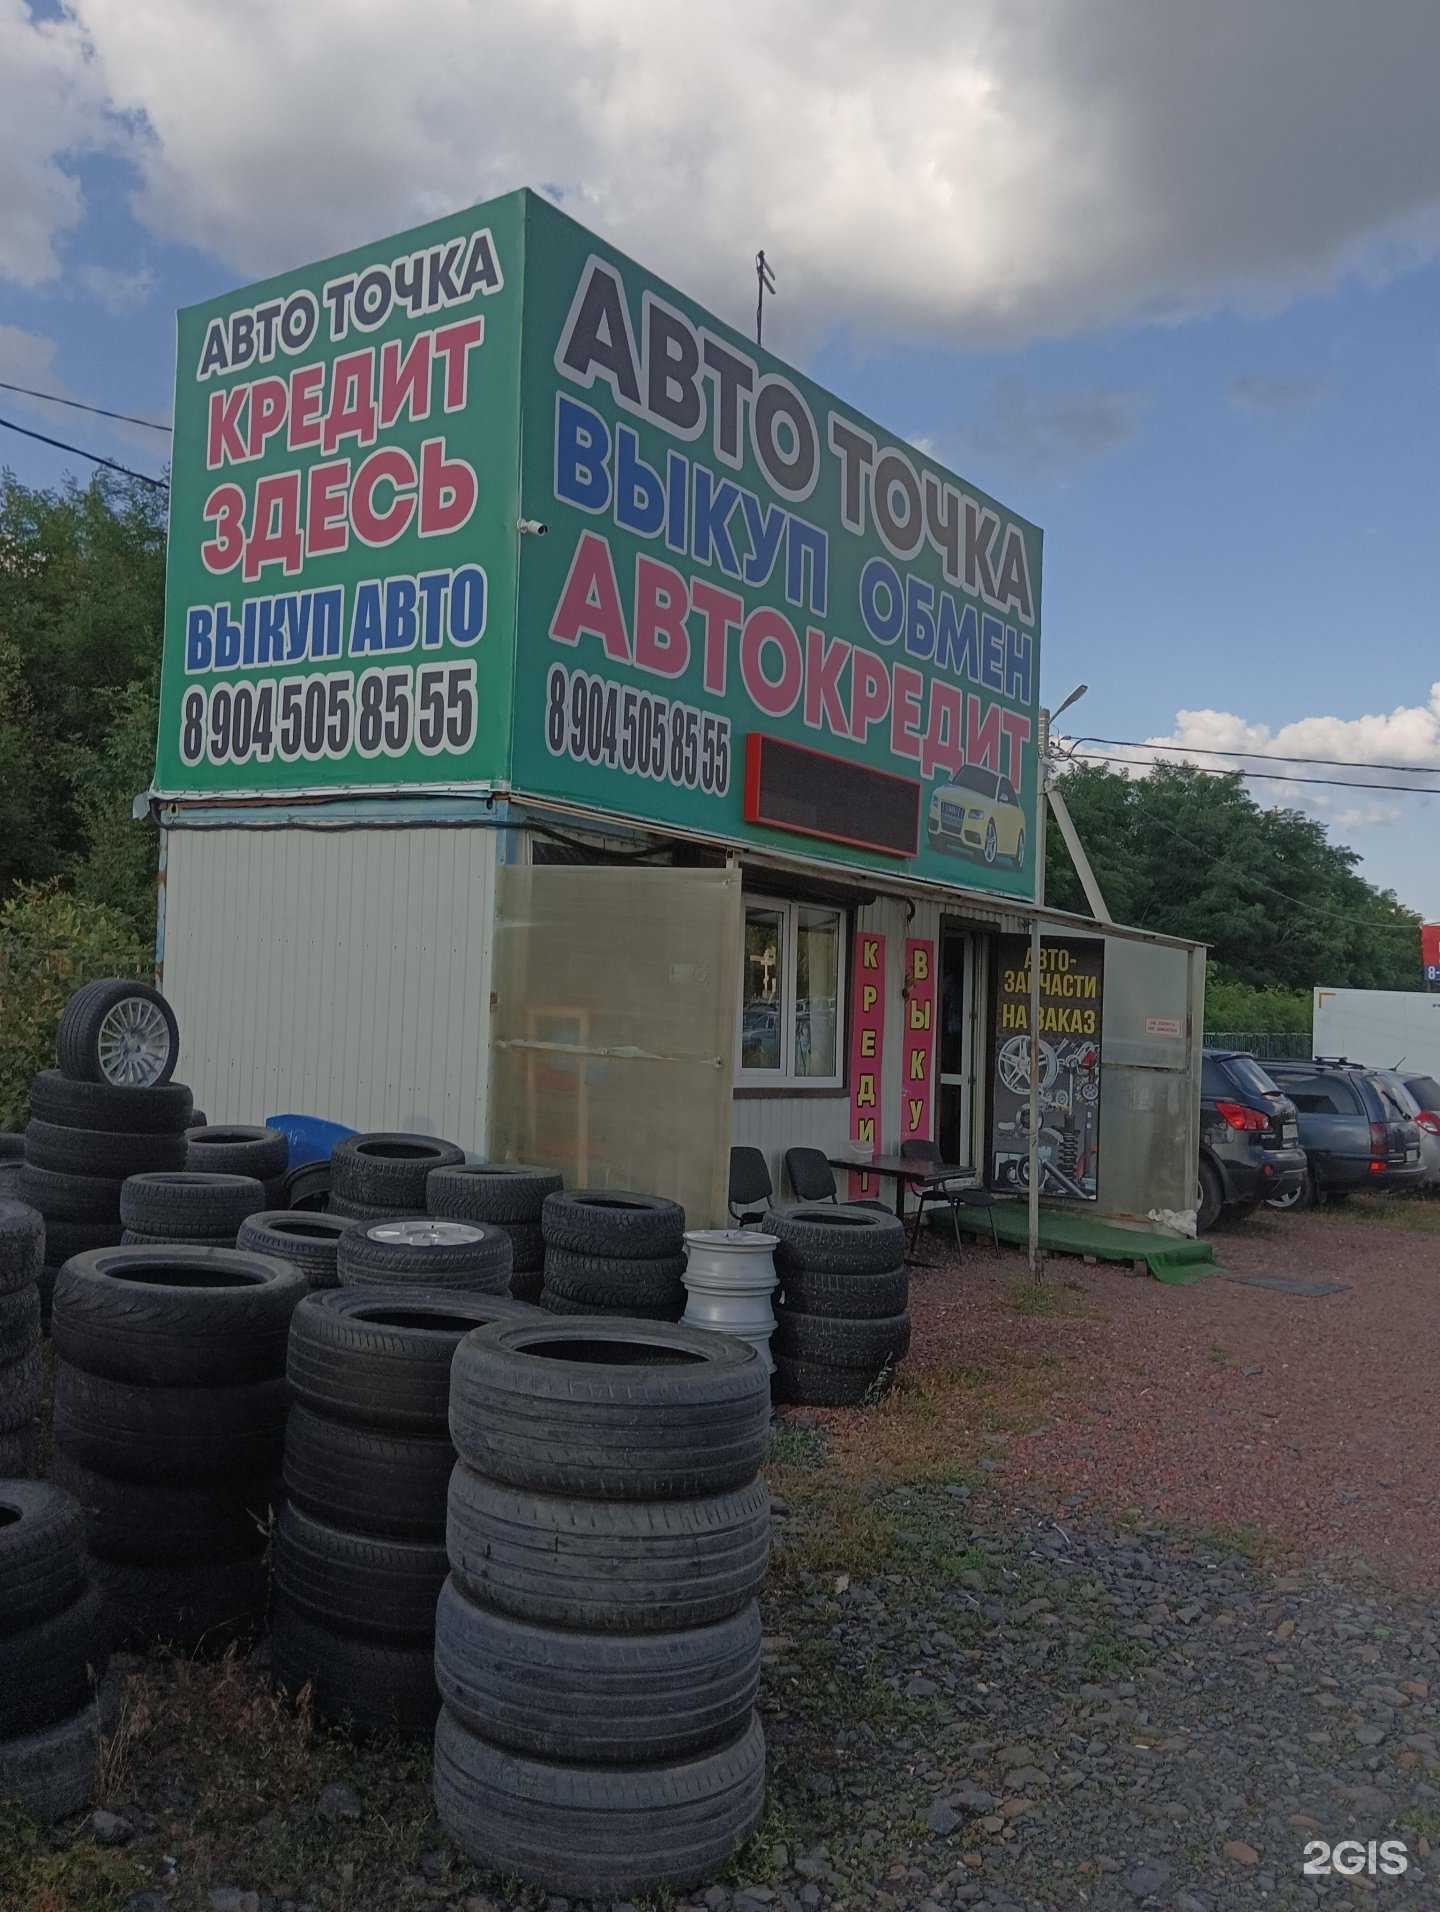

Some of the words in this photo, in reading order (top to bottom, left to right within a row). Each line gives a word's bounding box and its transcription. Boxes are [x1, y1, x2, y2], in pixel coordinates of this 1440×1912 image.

[198, 289, 319, 381] АВТО
[324, 228, 503, 341] ТОЧКА
[206, 315, 485, 470] КРЕДИТ
[555, 254, 819, 501] АВТО
[828, 411, 1035, 626] ТОЧКА
[201, 436, 478, 582] ЗДЕСЬ
[554, 391, 828, 617] ВЫКУП
[860, 557, 1033, 705] ОБМЕН
[184, 583, 344, 675] ВЫКУП
[348, 563, 487, 656] АВТО
[549, 529, 1031, 794] АВТОКРЕДИТ
[909, 948, 931, 1131] ВЫКУ
[1002, 1003, 1028, 1029] НА
[1004, 970, 1097, 998] ЗАЧАСТИ
